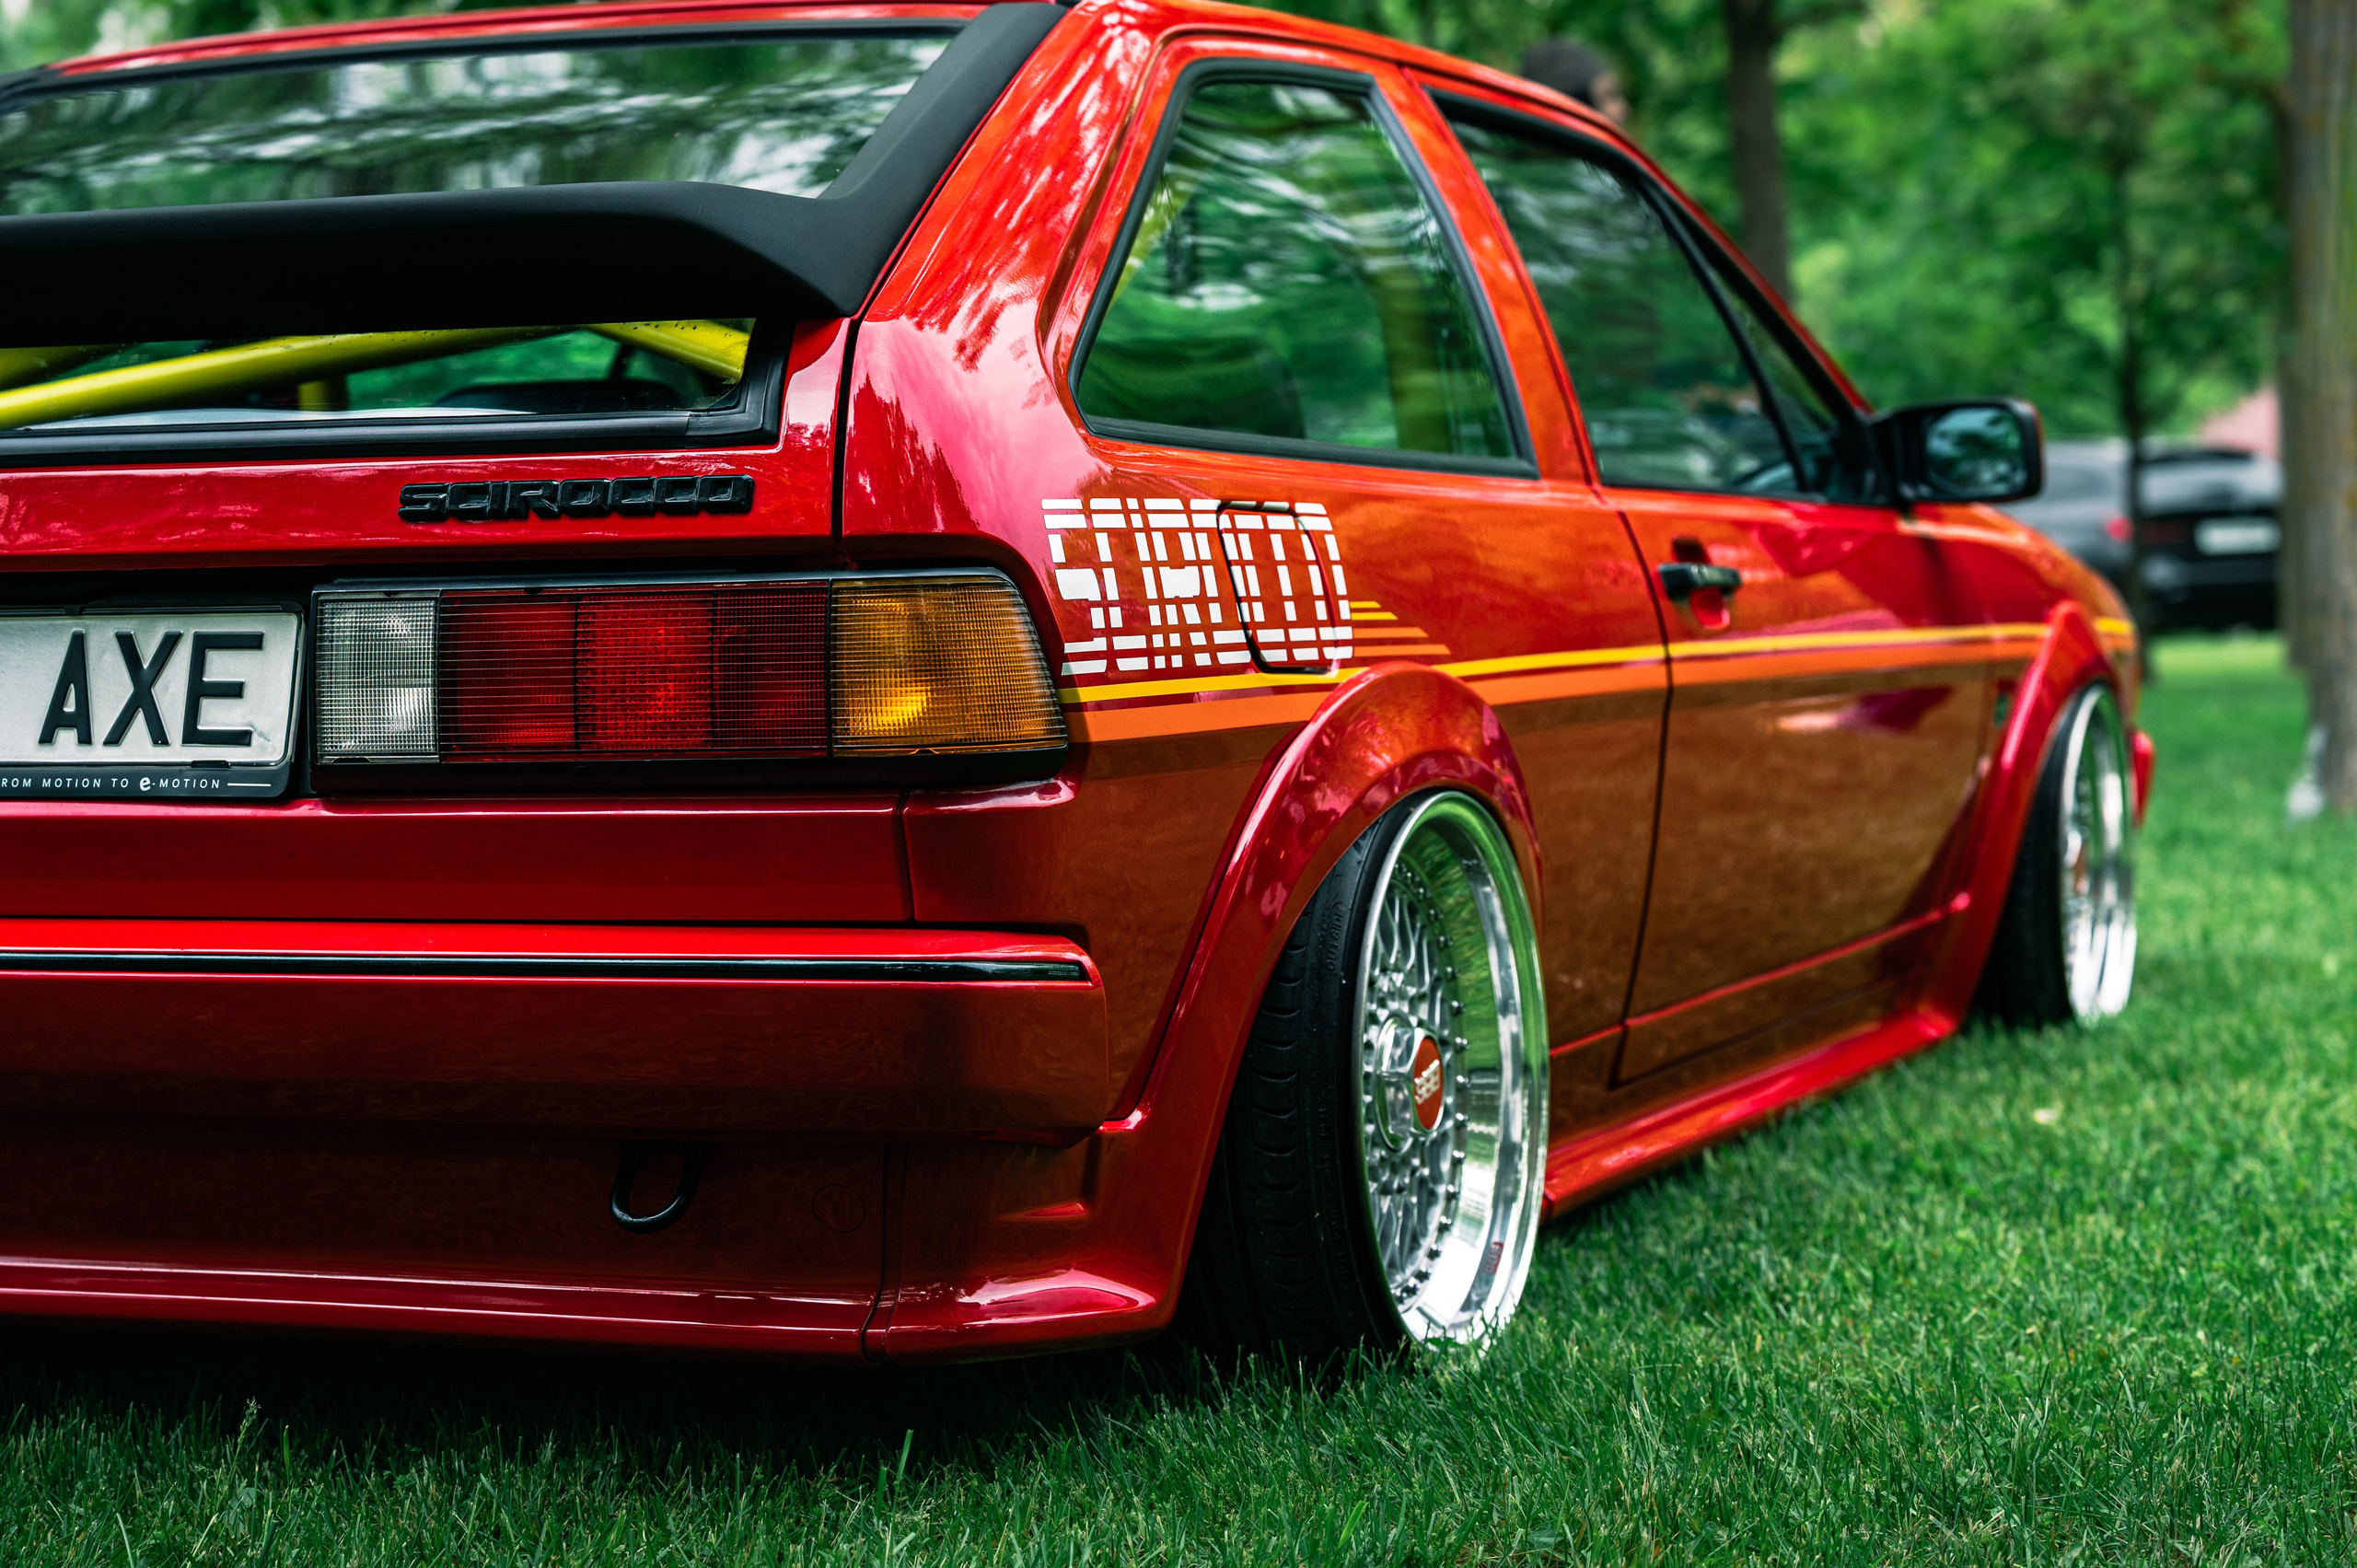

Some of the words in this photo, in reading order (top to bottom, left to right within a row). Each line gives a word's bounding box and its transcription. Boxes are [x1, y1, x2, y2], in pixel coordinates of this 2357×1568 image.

[398, 474, 755, 520] SCIROCCO
[38, 630, 265, 746] AXE
[1, 777, 31, 788] ROM
[41, 778, 101, 788] MOTION
[111, 778, 129, 788] TO
[140, 776, 220, 791] e-MOTION
[1413, 1059, 1440, 1105] BBS
